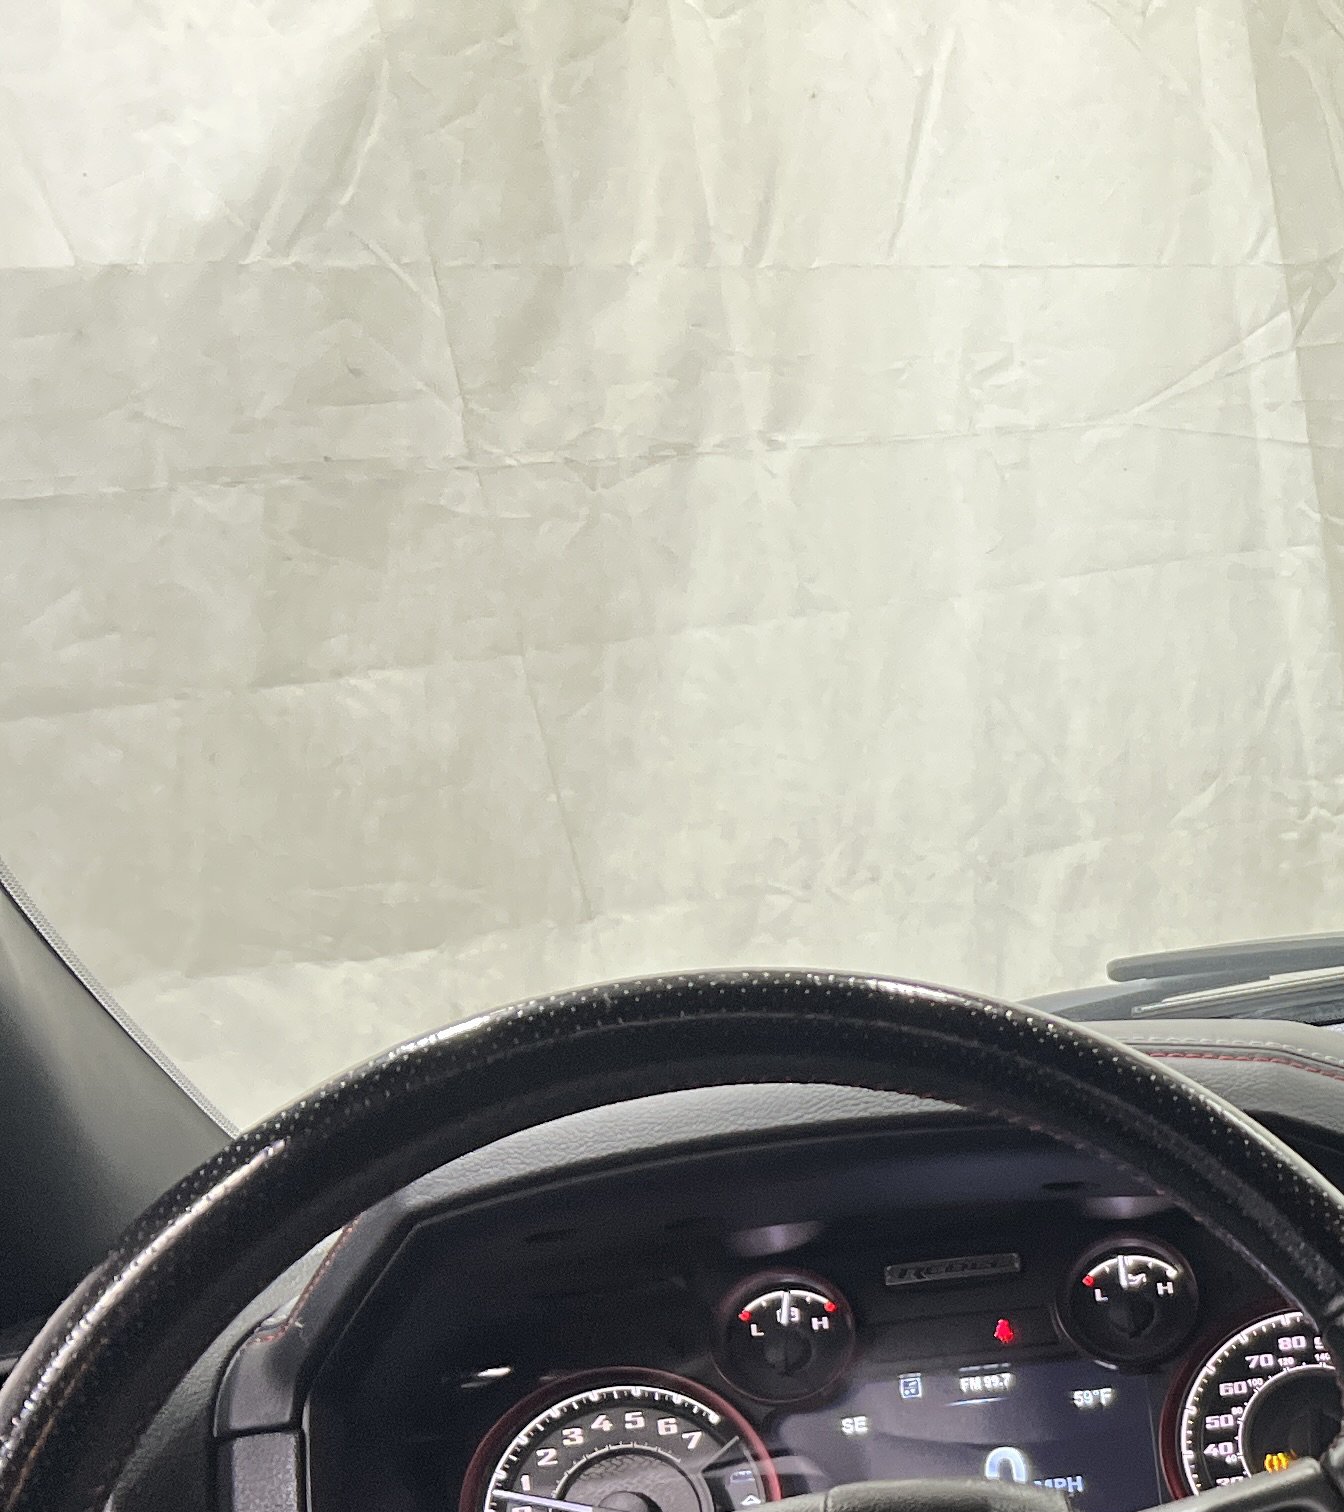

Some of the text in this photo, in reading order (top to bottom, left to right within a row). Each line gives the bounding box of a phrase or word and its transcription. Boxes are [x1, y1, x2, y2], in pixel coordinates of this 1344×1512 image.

[1094, 1288, 1109, 1302] L
[1156, 1281, 1174, 1296] H
[750, 1323, 765, 1337] L
[811, 1316, 829, 1331] H
[1277, 1335, 1307, 1351] 80
[1245, 1354, 1274, 1369] 70
[1219, 1381, 1248, 1397] 60
[1247, 1378, 1264, 1388] 100
[590, 1414, 614, 1432] 4
[624, 1411, 645, 1429] 5
[656, 1417, 678, 1436] 6
[840, 1415, 869, 1435] SE
[1205, 1414, 1234, 1430] 50
[562, 1427, 584, 1446] 3
[681, 1430, 702, 1450] 7
[536, 1447, 559, 1467] 2
[1203, 1441, 1234, 1458] 40
[520, 1474, 531, 1492] 1
